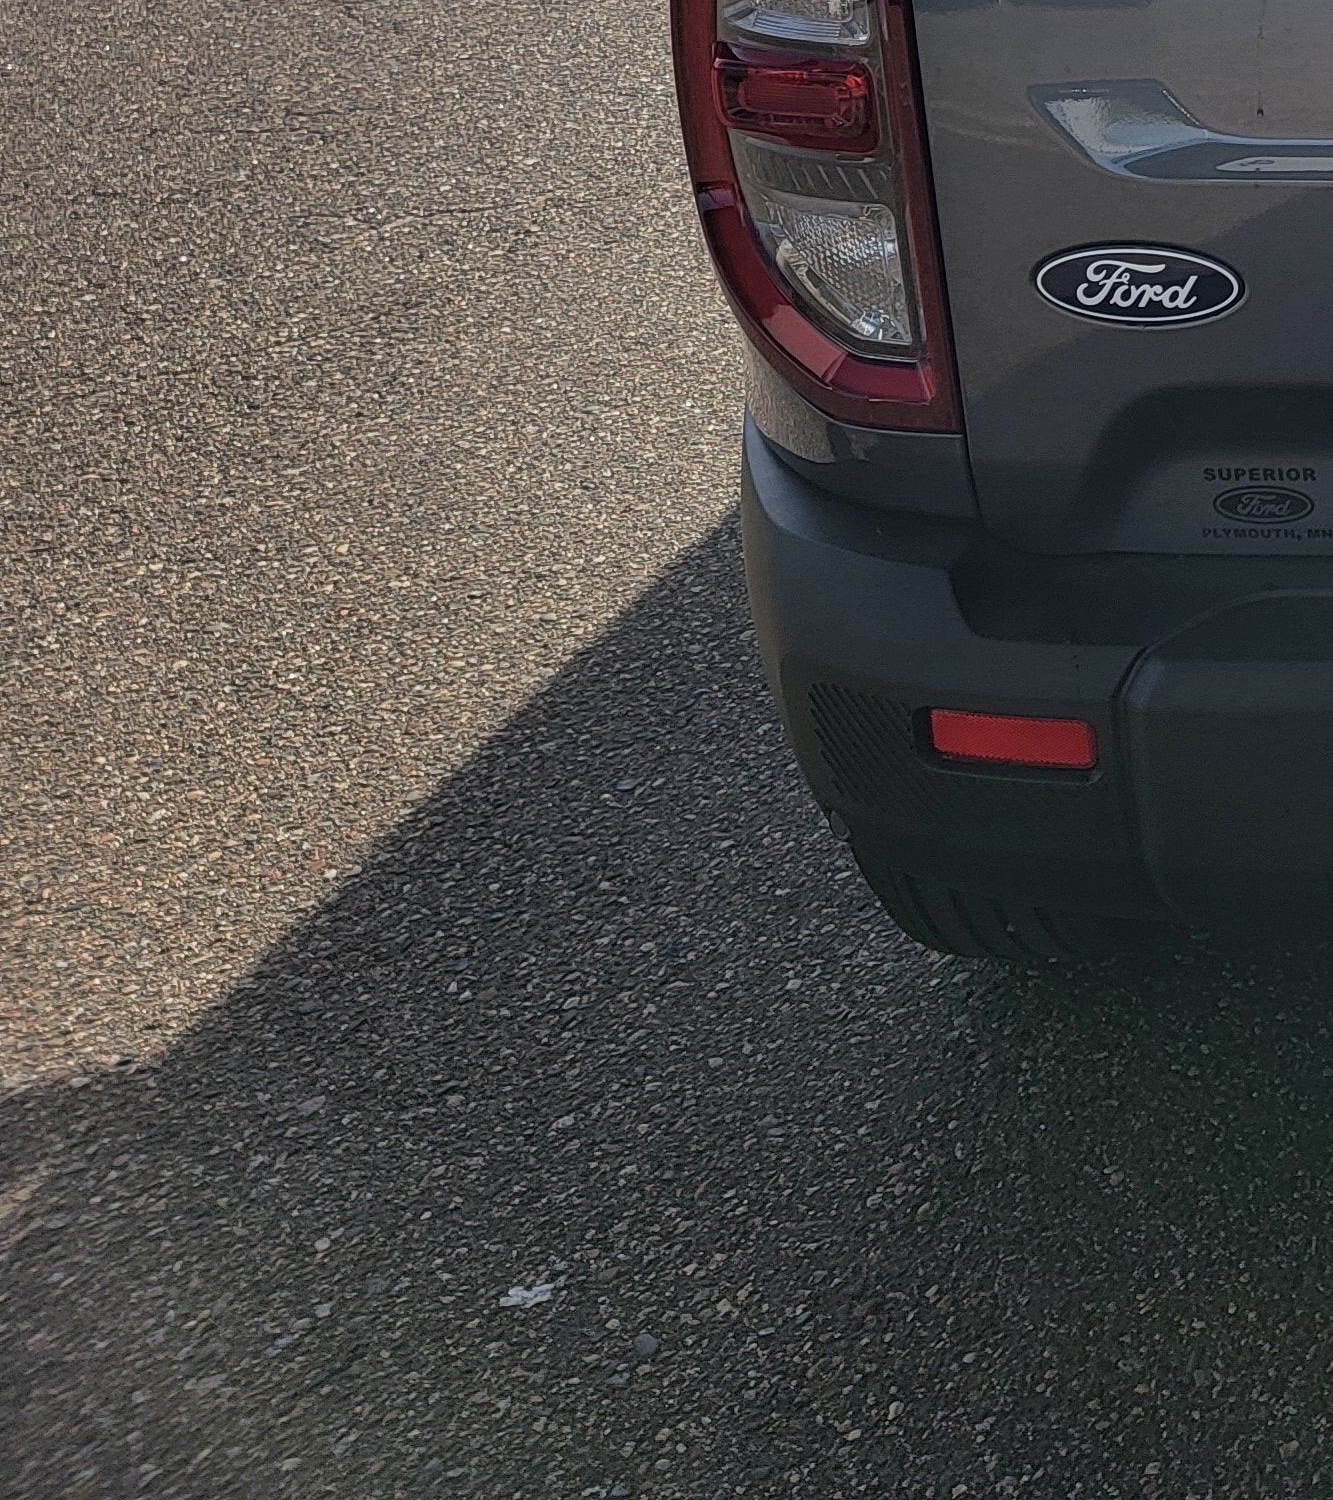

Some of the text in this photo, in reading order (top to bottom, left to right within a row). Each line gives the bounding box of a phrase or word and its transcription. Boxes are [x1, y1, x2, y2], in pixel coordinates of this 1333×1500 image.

[1076, 260, 1198, 309] Ford
[1202, 467, 1317, 482] SUPERIOR
[1236, 493, 1291, 516] Ford
[1202, 528, 1333, 541] PLYMOUTH, MN
